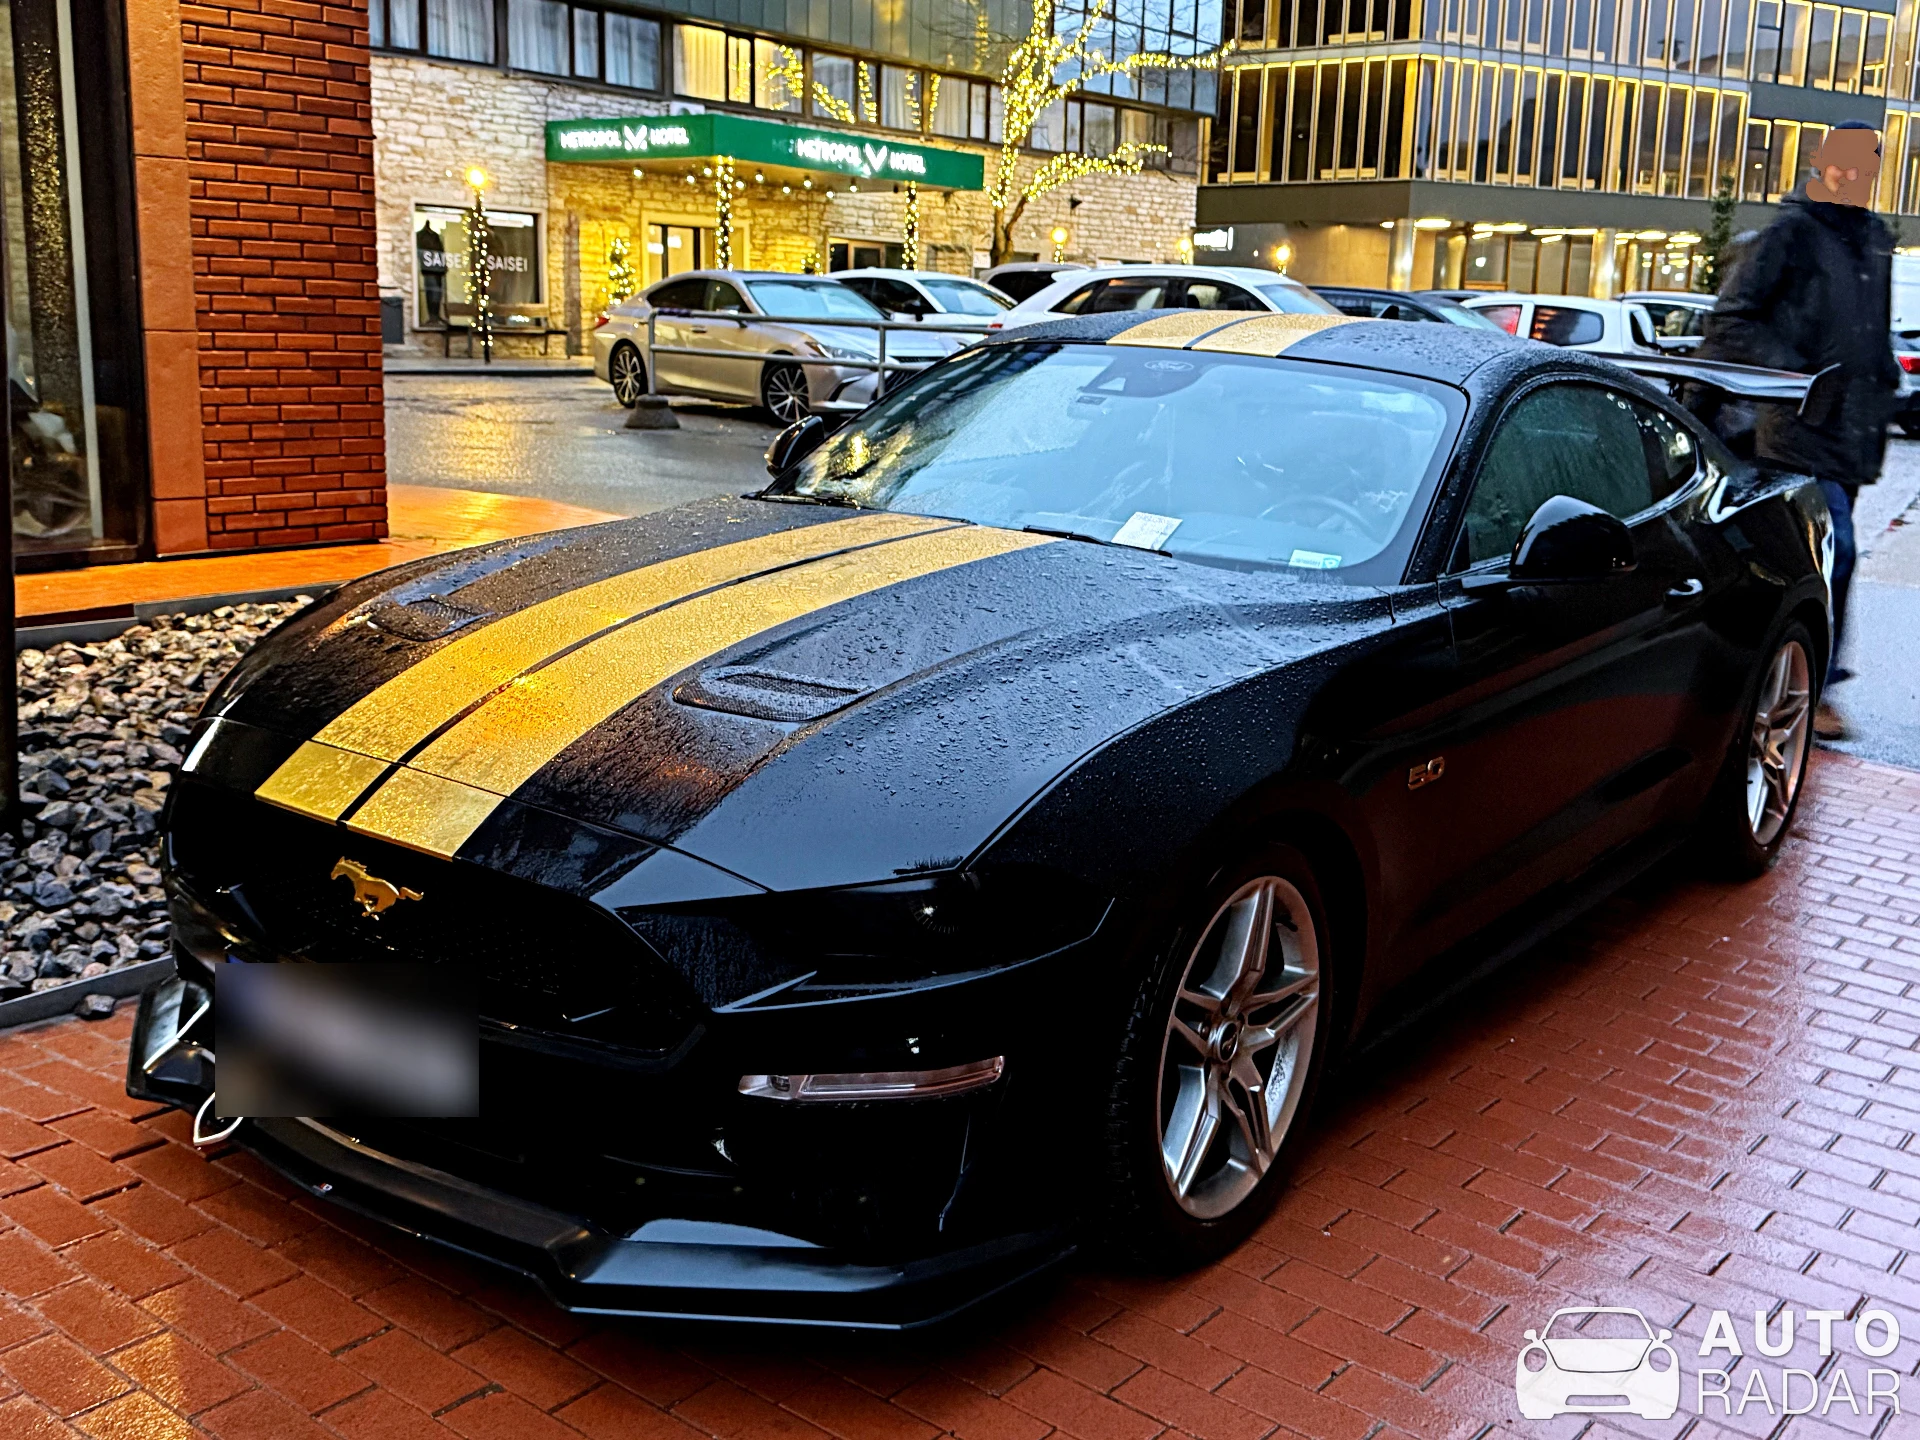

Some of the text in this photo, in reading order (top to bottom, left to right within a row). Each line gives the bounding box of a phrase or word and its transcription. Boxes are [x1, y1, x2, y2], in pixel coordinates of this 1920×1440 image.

[560, 127, 690, 149] METROPOL HOTEL
[797, 138, 927, 174] METROPOL HOTEL
[486, 254, 528, 272] SAISEI
